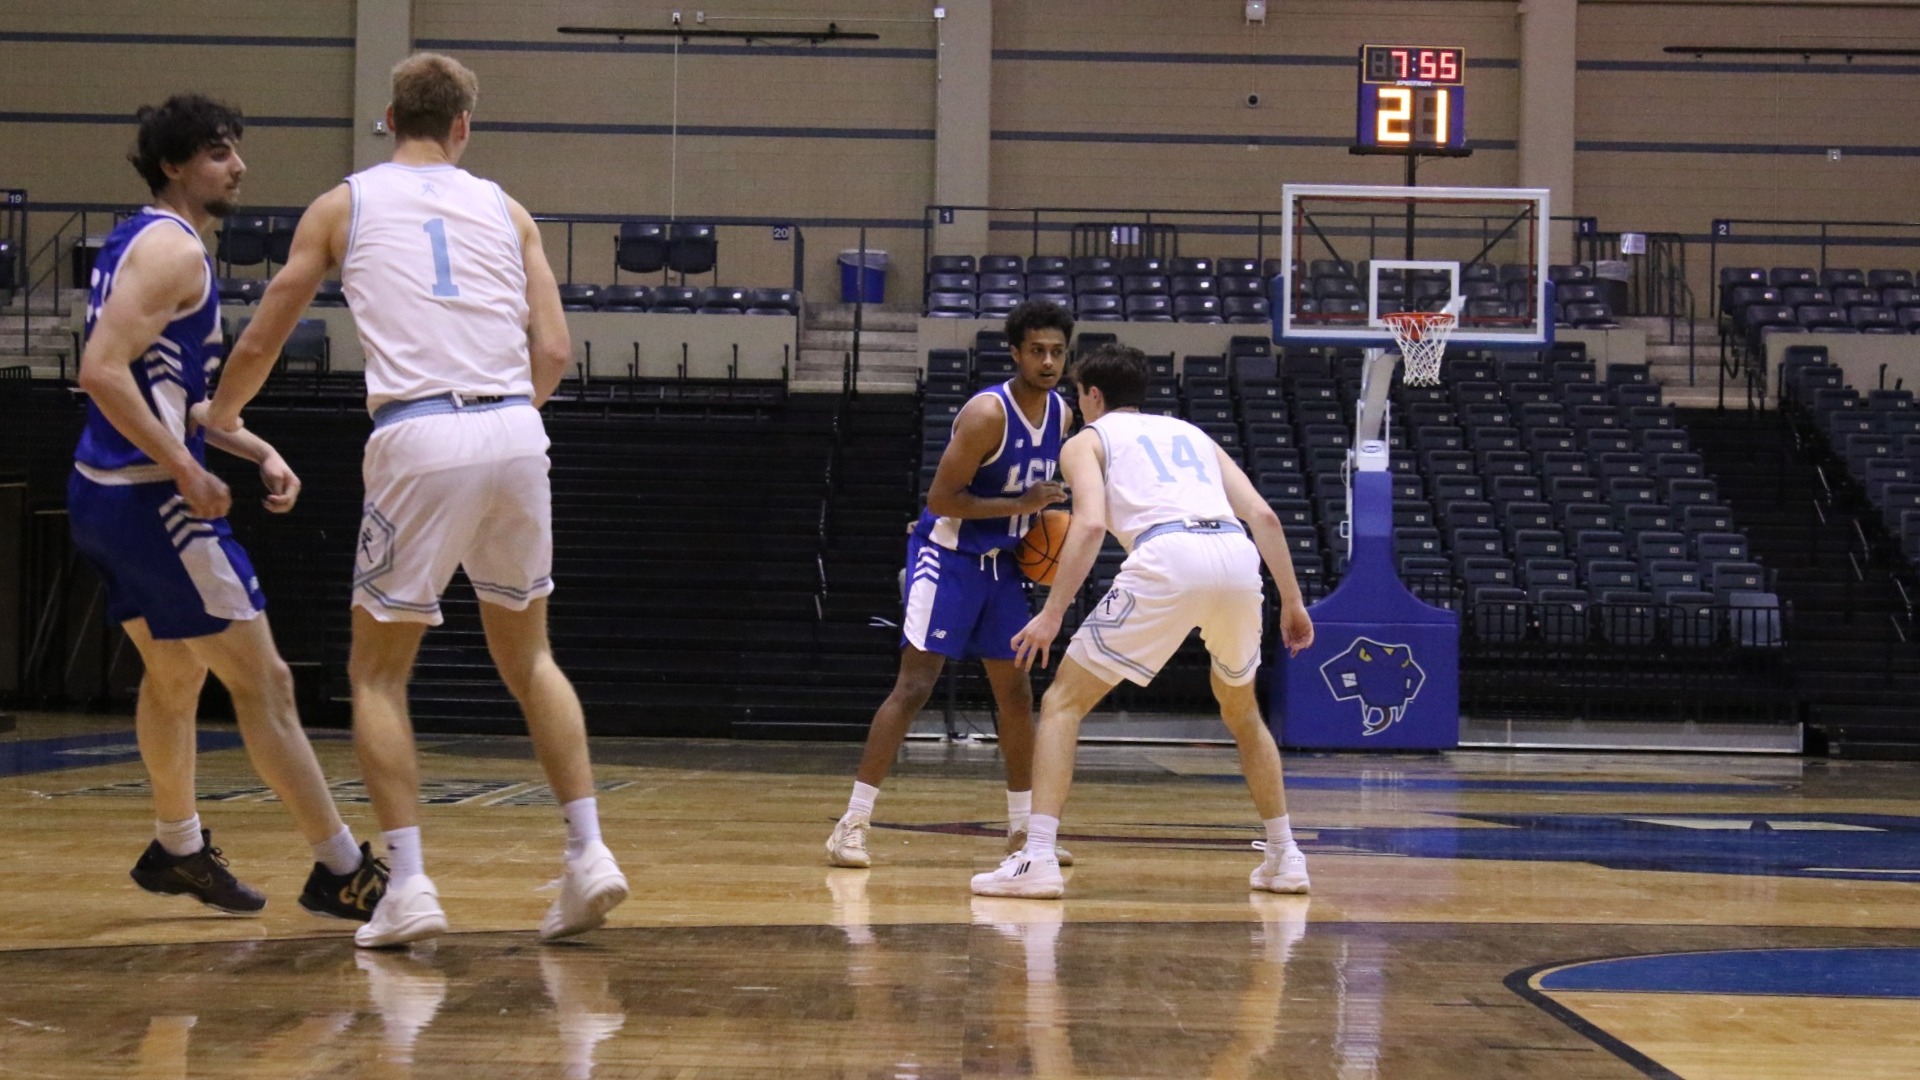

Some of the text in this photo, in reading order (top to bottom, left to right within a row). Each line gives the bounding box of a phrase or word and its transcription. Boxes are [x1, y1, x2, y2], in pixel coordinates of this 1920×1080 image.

[1391, 51, 1457, 79] 7:55
[1378, 88, 1448, 143] 21
[10, 194, 22, 204] 19
[943, 211, 950, 222] 1
[774, 228, 788, 238] 20
[1582, 222, 1588, 233] 1
[1719, 224, 1727, 235] 2
[423, 218, 460, 297] 1
[1137, 434, 1212, 486] 14
